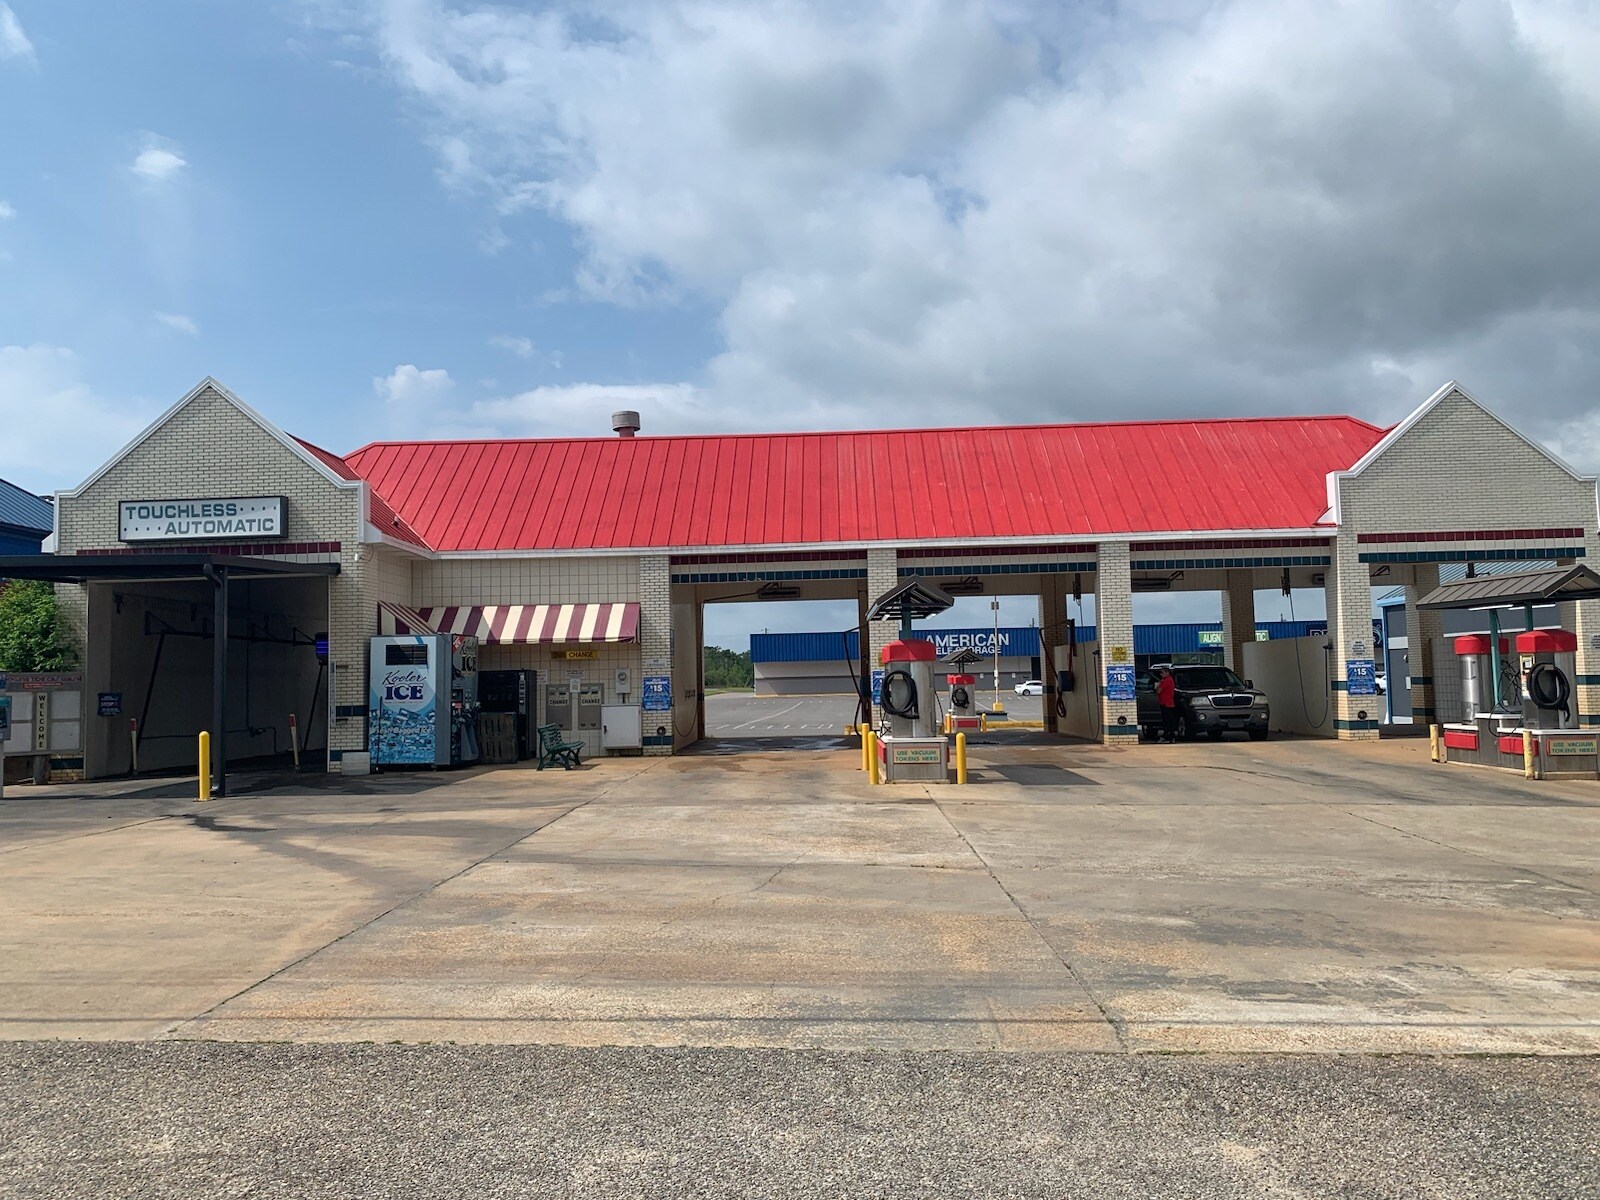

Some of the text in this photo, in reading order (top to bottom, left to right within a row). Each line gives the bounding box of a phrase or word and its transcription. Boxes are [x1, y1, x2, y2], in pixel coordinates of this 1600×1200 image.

[125, 502, 237, 519] TOUCHLESS
[164, 518, 274, 535] AUTOMATIC
[926, 633, 1009, 647] AMERICAN
[1203, 633, 1221, 643] ALIGN
[568, 651, 593, 659] CHANGE
[382, 670, 427, 686] Kooler
[384, 683, 423, 700] ICE
